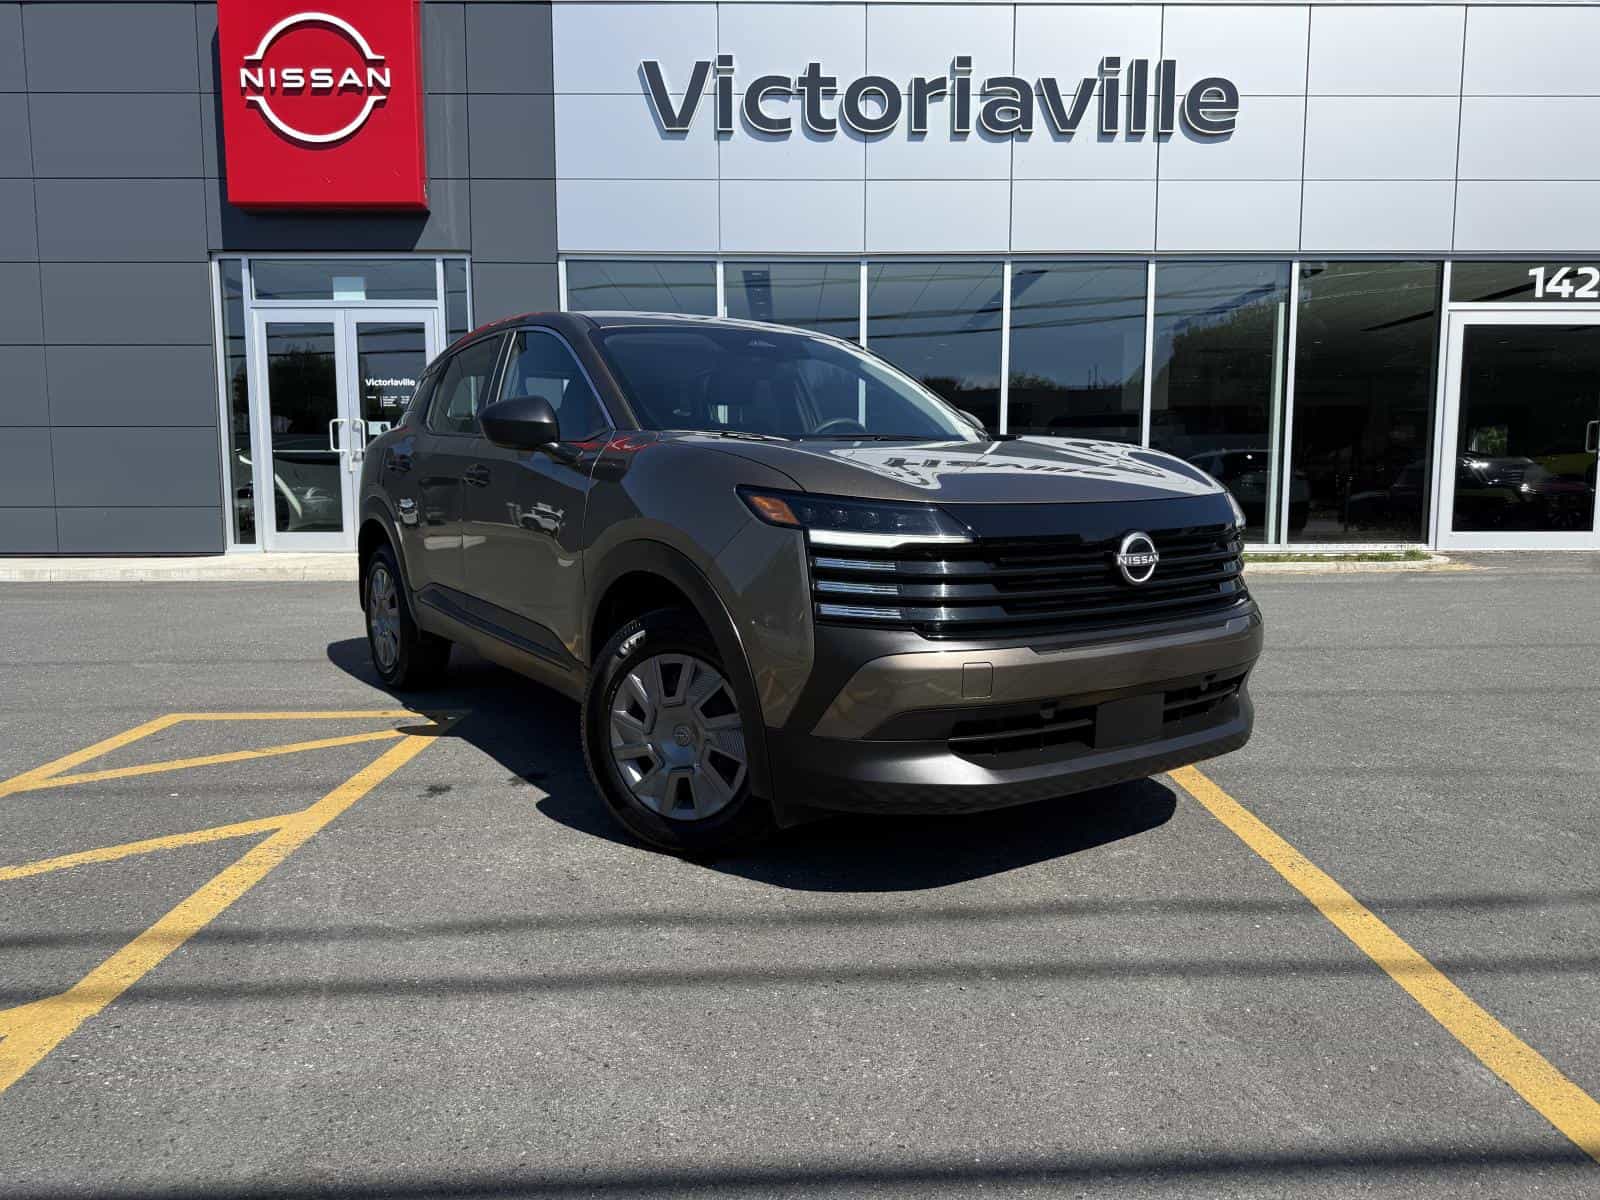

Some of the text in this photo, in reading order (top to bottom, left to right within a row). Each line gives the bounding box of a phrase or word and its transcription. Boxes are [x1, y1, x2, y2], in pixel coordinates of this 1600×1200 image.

[239, 67, 391, 88] NISSAN
[639, 54, 1240, 137] Victoriaville
[1528, 266, 1600, 298] 142
[365, 378, 416, 387] Victoriaville
[1117, 553, 1159, 566] NISSAN
